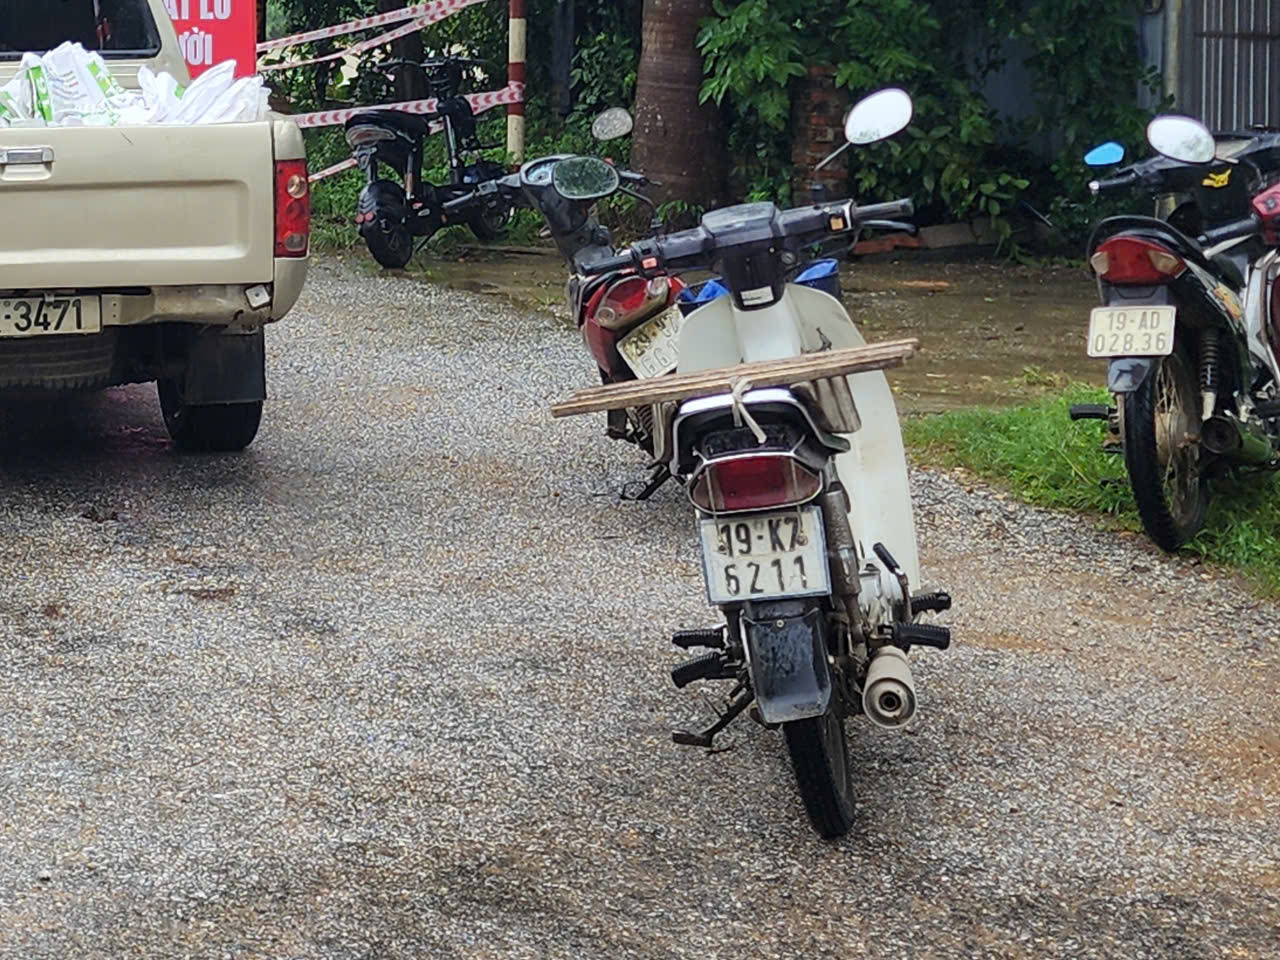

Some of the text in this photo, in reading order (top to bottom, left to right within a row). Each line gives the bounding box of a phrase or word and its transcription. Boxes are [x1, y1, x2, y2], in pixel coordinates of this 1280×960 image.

[1107, 311, 1161, 331] 19-AD
[1094, 332, 1167, 354] 028.36
[724, 555, 808, 596] 6211
